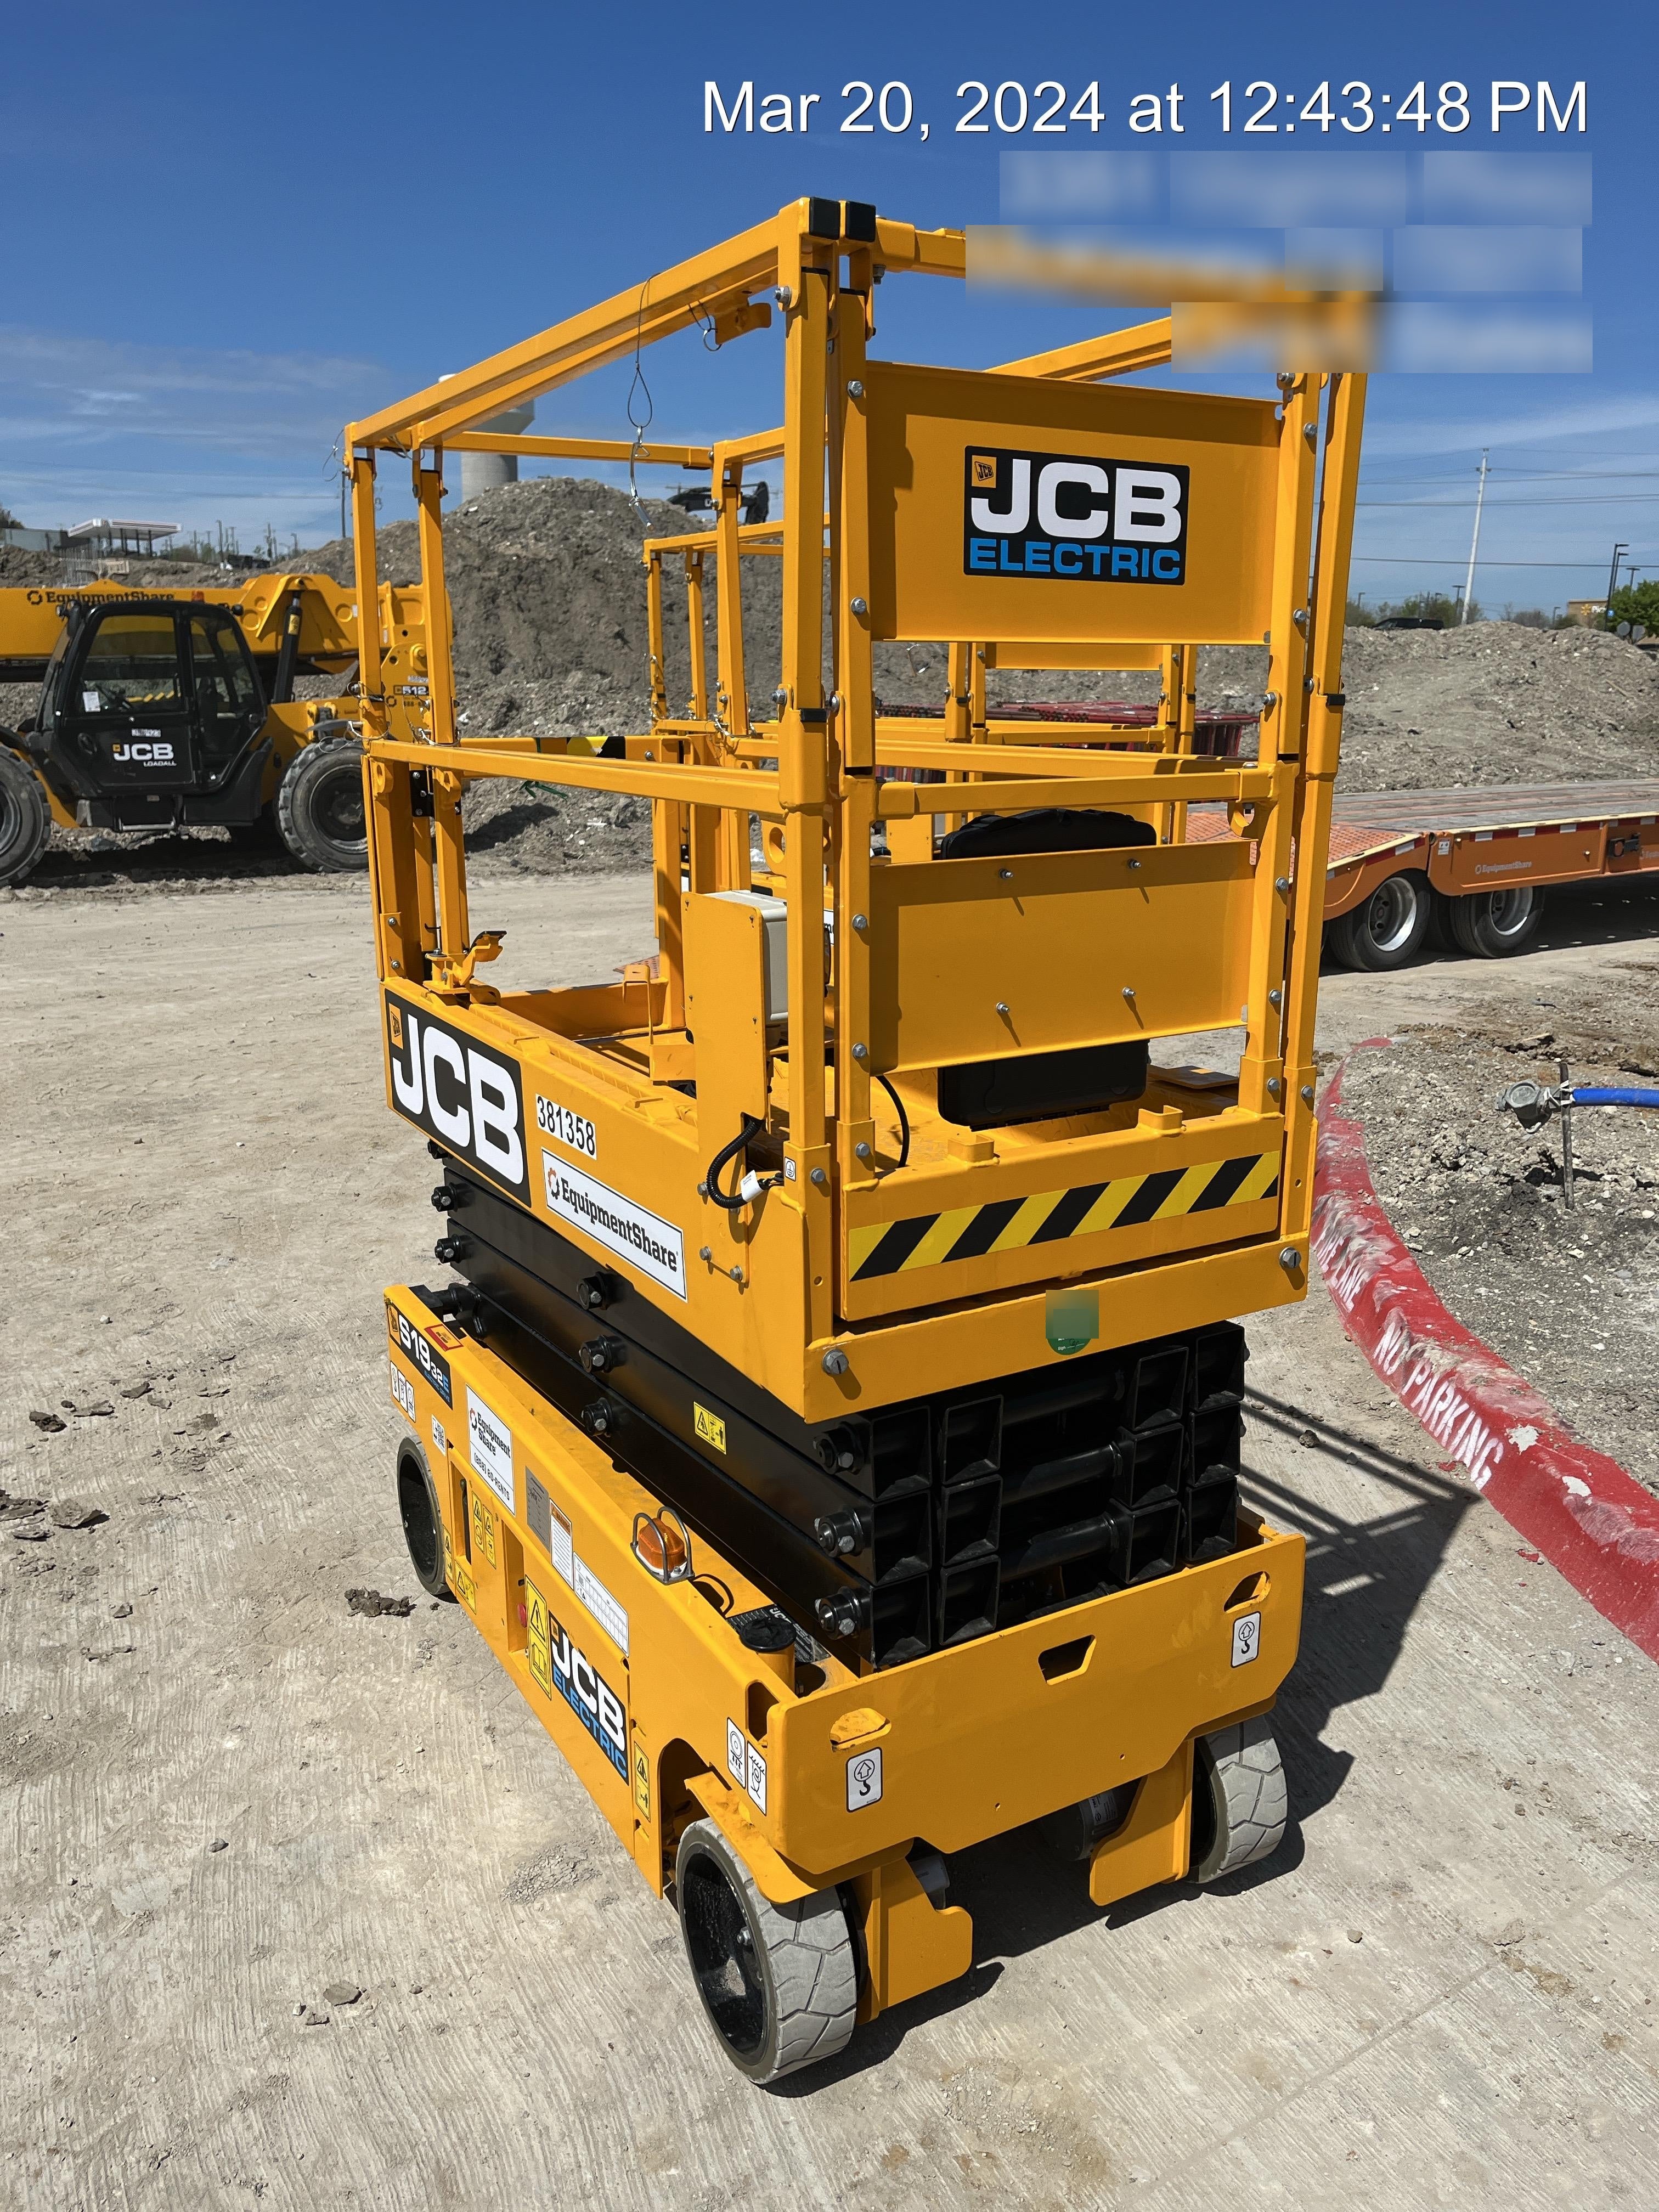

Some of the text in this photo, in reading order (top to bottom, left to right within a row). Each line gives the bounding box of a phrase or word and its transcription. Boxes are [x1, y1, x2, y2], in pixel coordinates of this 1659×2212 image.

[971, 458, 1182, 543] JCB
[970, 538, 1180, 579] ELECTRIC
[113, 743, 174, 761] JCB
[392, 1013, 524, 1185] JCB
[537, 1096, 595, 1156] 381358
[561, 1177, 678, 1273] EquipmentShare
[477, 1412, 511, 1459] Equipment
[478, 1427, 496, 1457] Share
[1373, 1322, 1410, 1375] NO
[1402, 1358, 1504, 1491] PARKING
[551, 1632, 625, 1752] JCB
[552, 1663, 627, 1779] ELECTRIC
